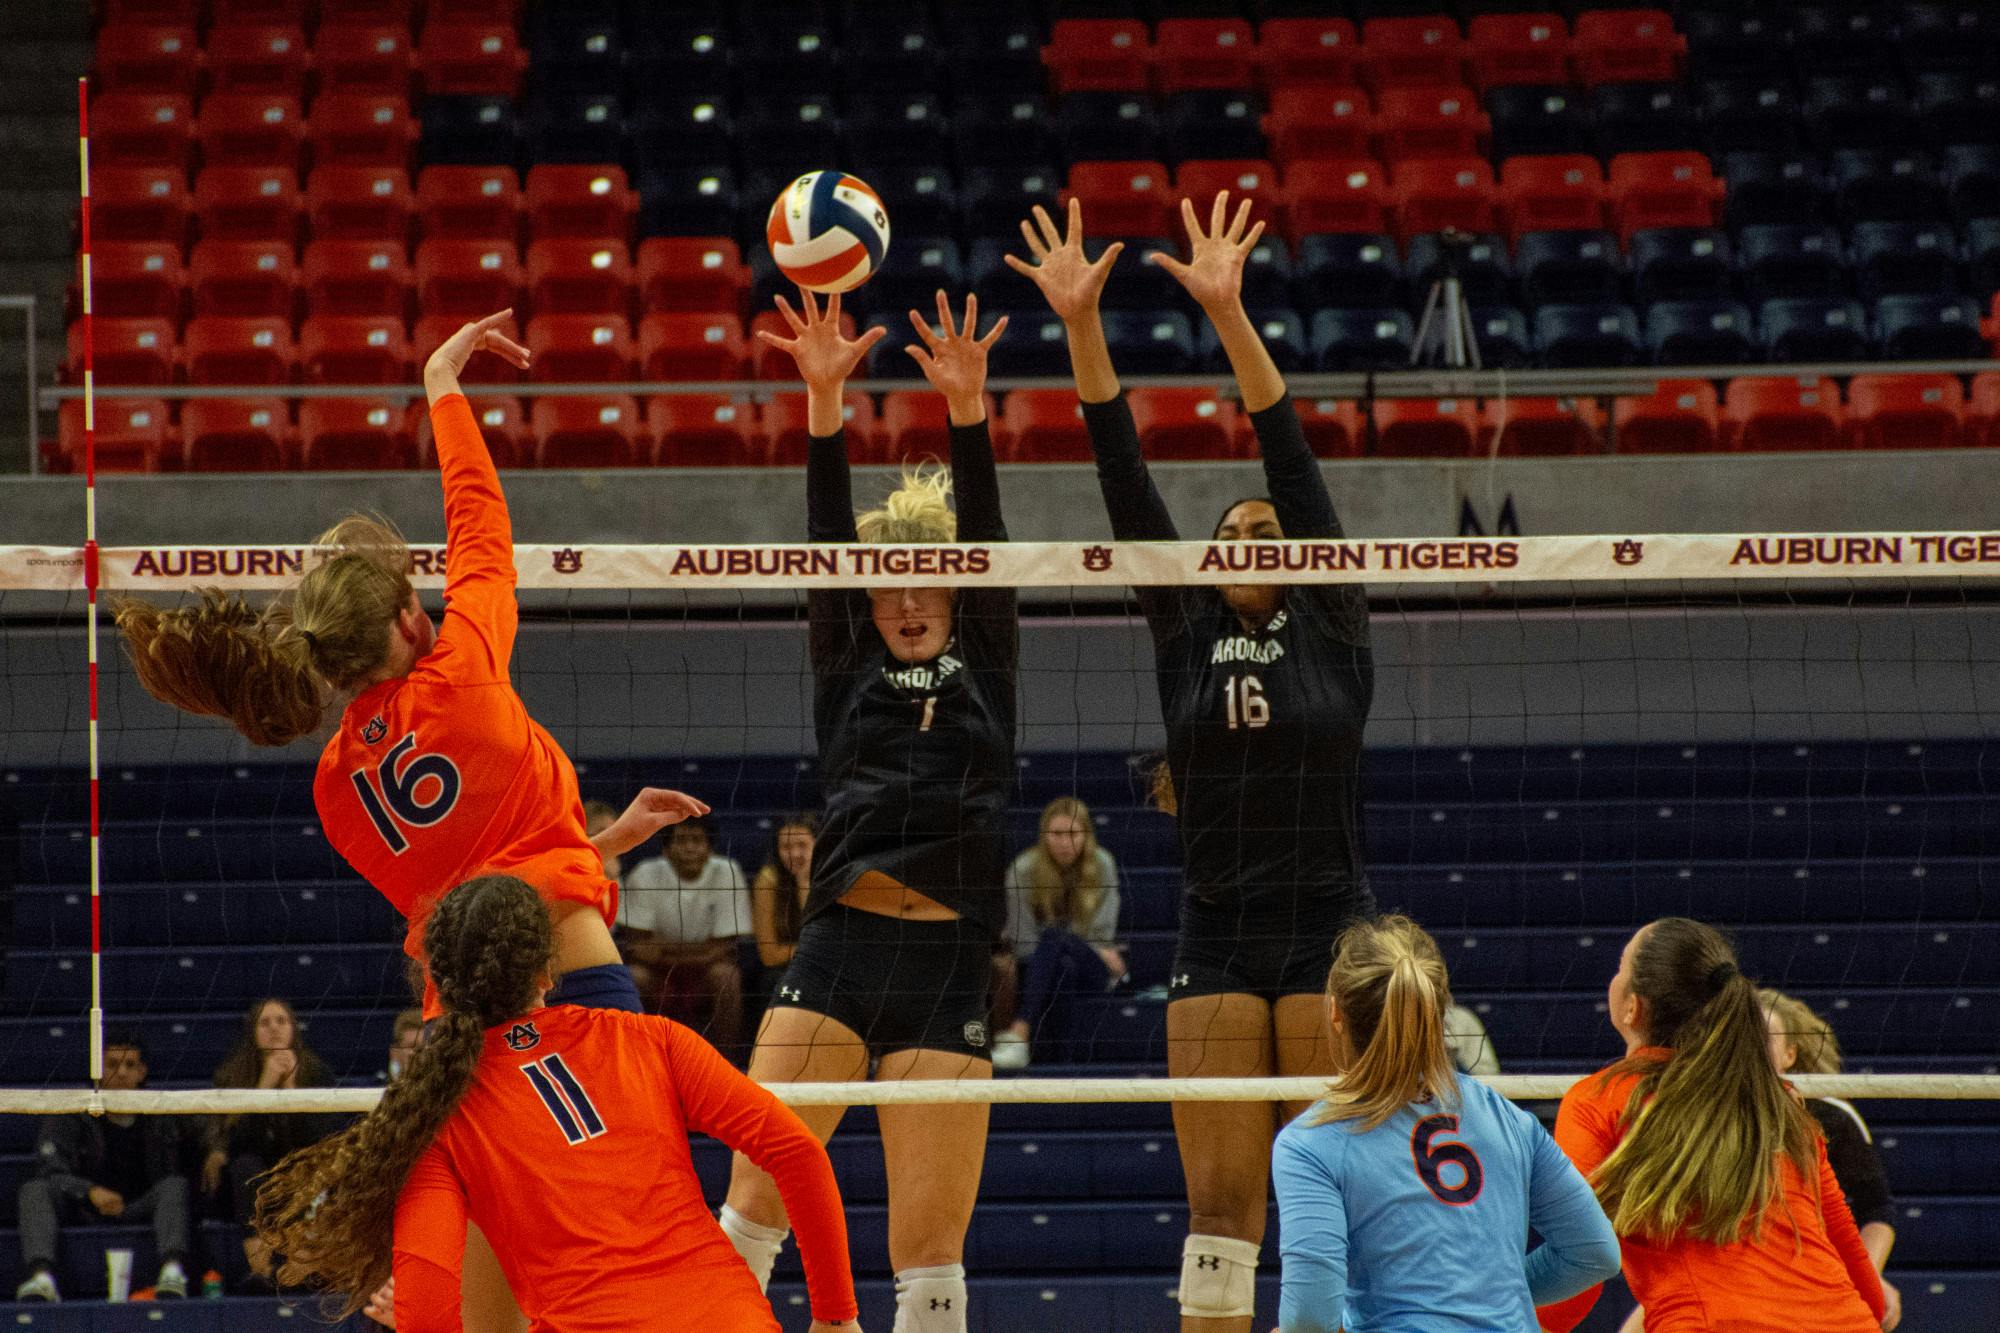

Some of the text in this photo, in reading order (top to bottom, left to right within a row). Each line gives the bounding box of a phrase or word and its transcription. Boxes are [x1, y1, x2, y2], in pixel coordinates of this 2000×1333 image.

[132, 550, 303, 576] AUBURN
[670, 548, 990, 575] AUBURN TIGERS
[1198, 542, 1519, 571] AUBURN TIGERS
[1729, 538, 1902, 565] AUBURN
[1225, 675, 1270, 729] 16
[350, 731, 461, 857] 16
[519, 1052, 608, 1146] 11
[1410, 1113, 1484, 1207] 6
